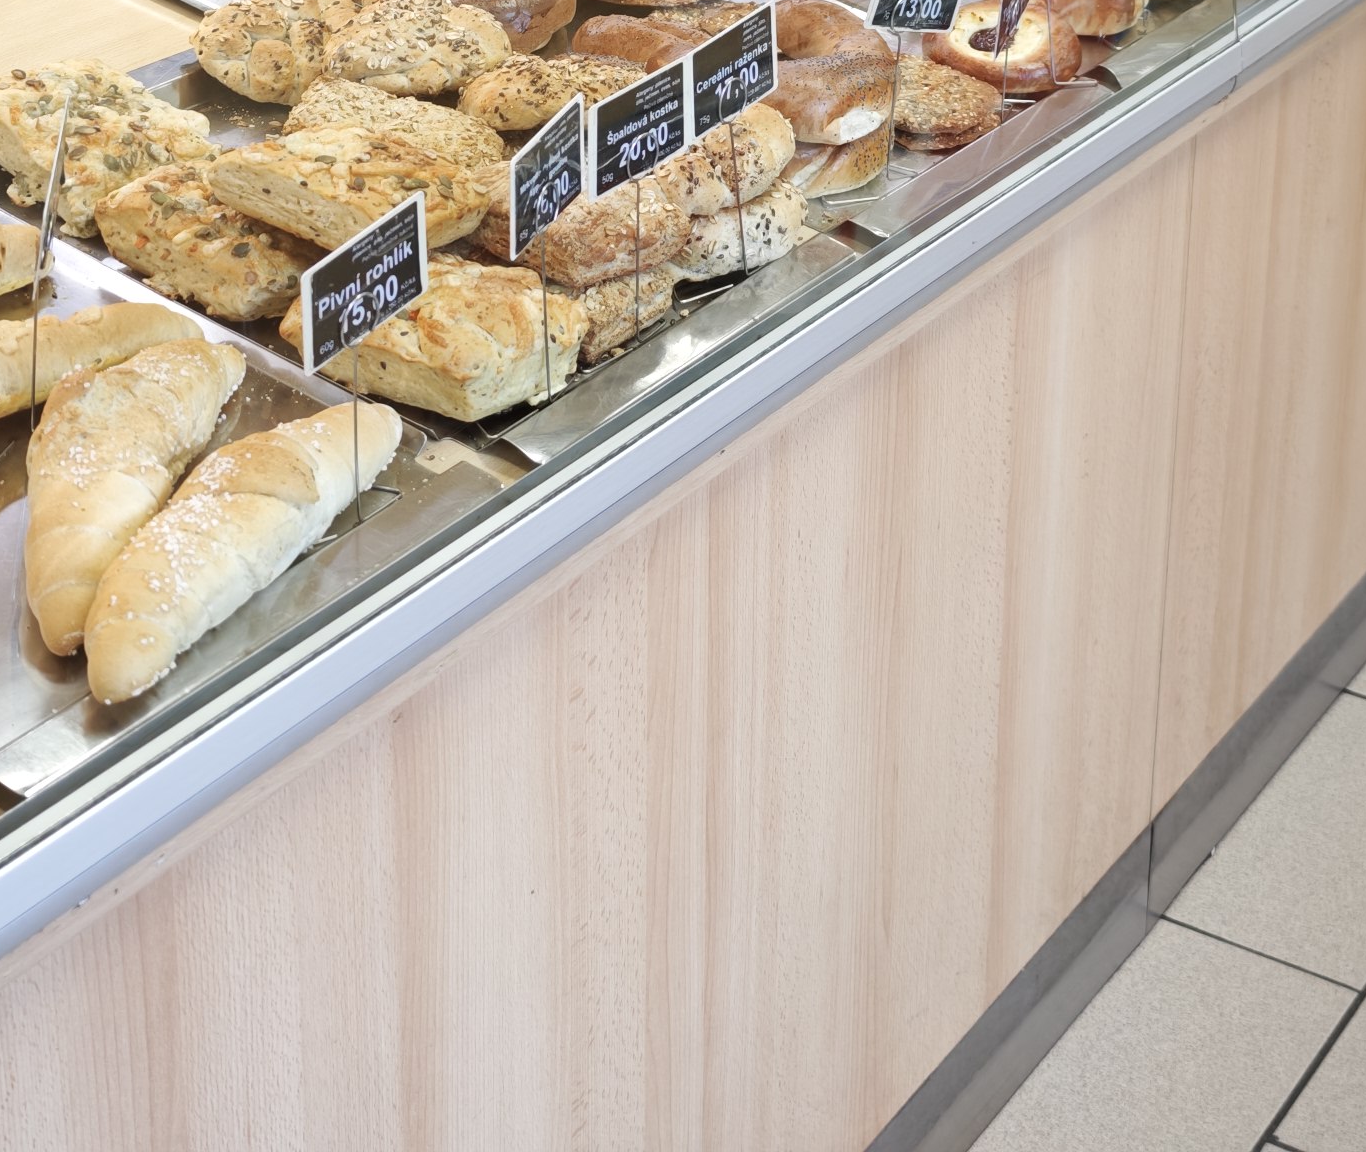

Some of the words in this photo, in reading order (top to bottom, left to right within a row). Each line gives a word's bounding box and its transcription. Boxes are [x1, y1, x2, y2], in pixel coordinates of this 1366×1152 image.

[696, 65, 733, 94] Cereální
[735, 43, 768, 74] raženka
[715, 61, 759, 100] 17,00
[606, 118, 648, 147] Špaldová
[650, 99, 679, 123] kostka
[619, 121, 668, 169] 20,00
[602, 174, 614, 186] 50g
[318, 272, 361, 320] Pivní
[366, 239, 413, 287] rohlík
[338, 274, 399, 333] 15,00
